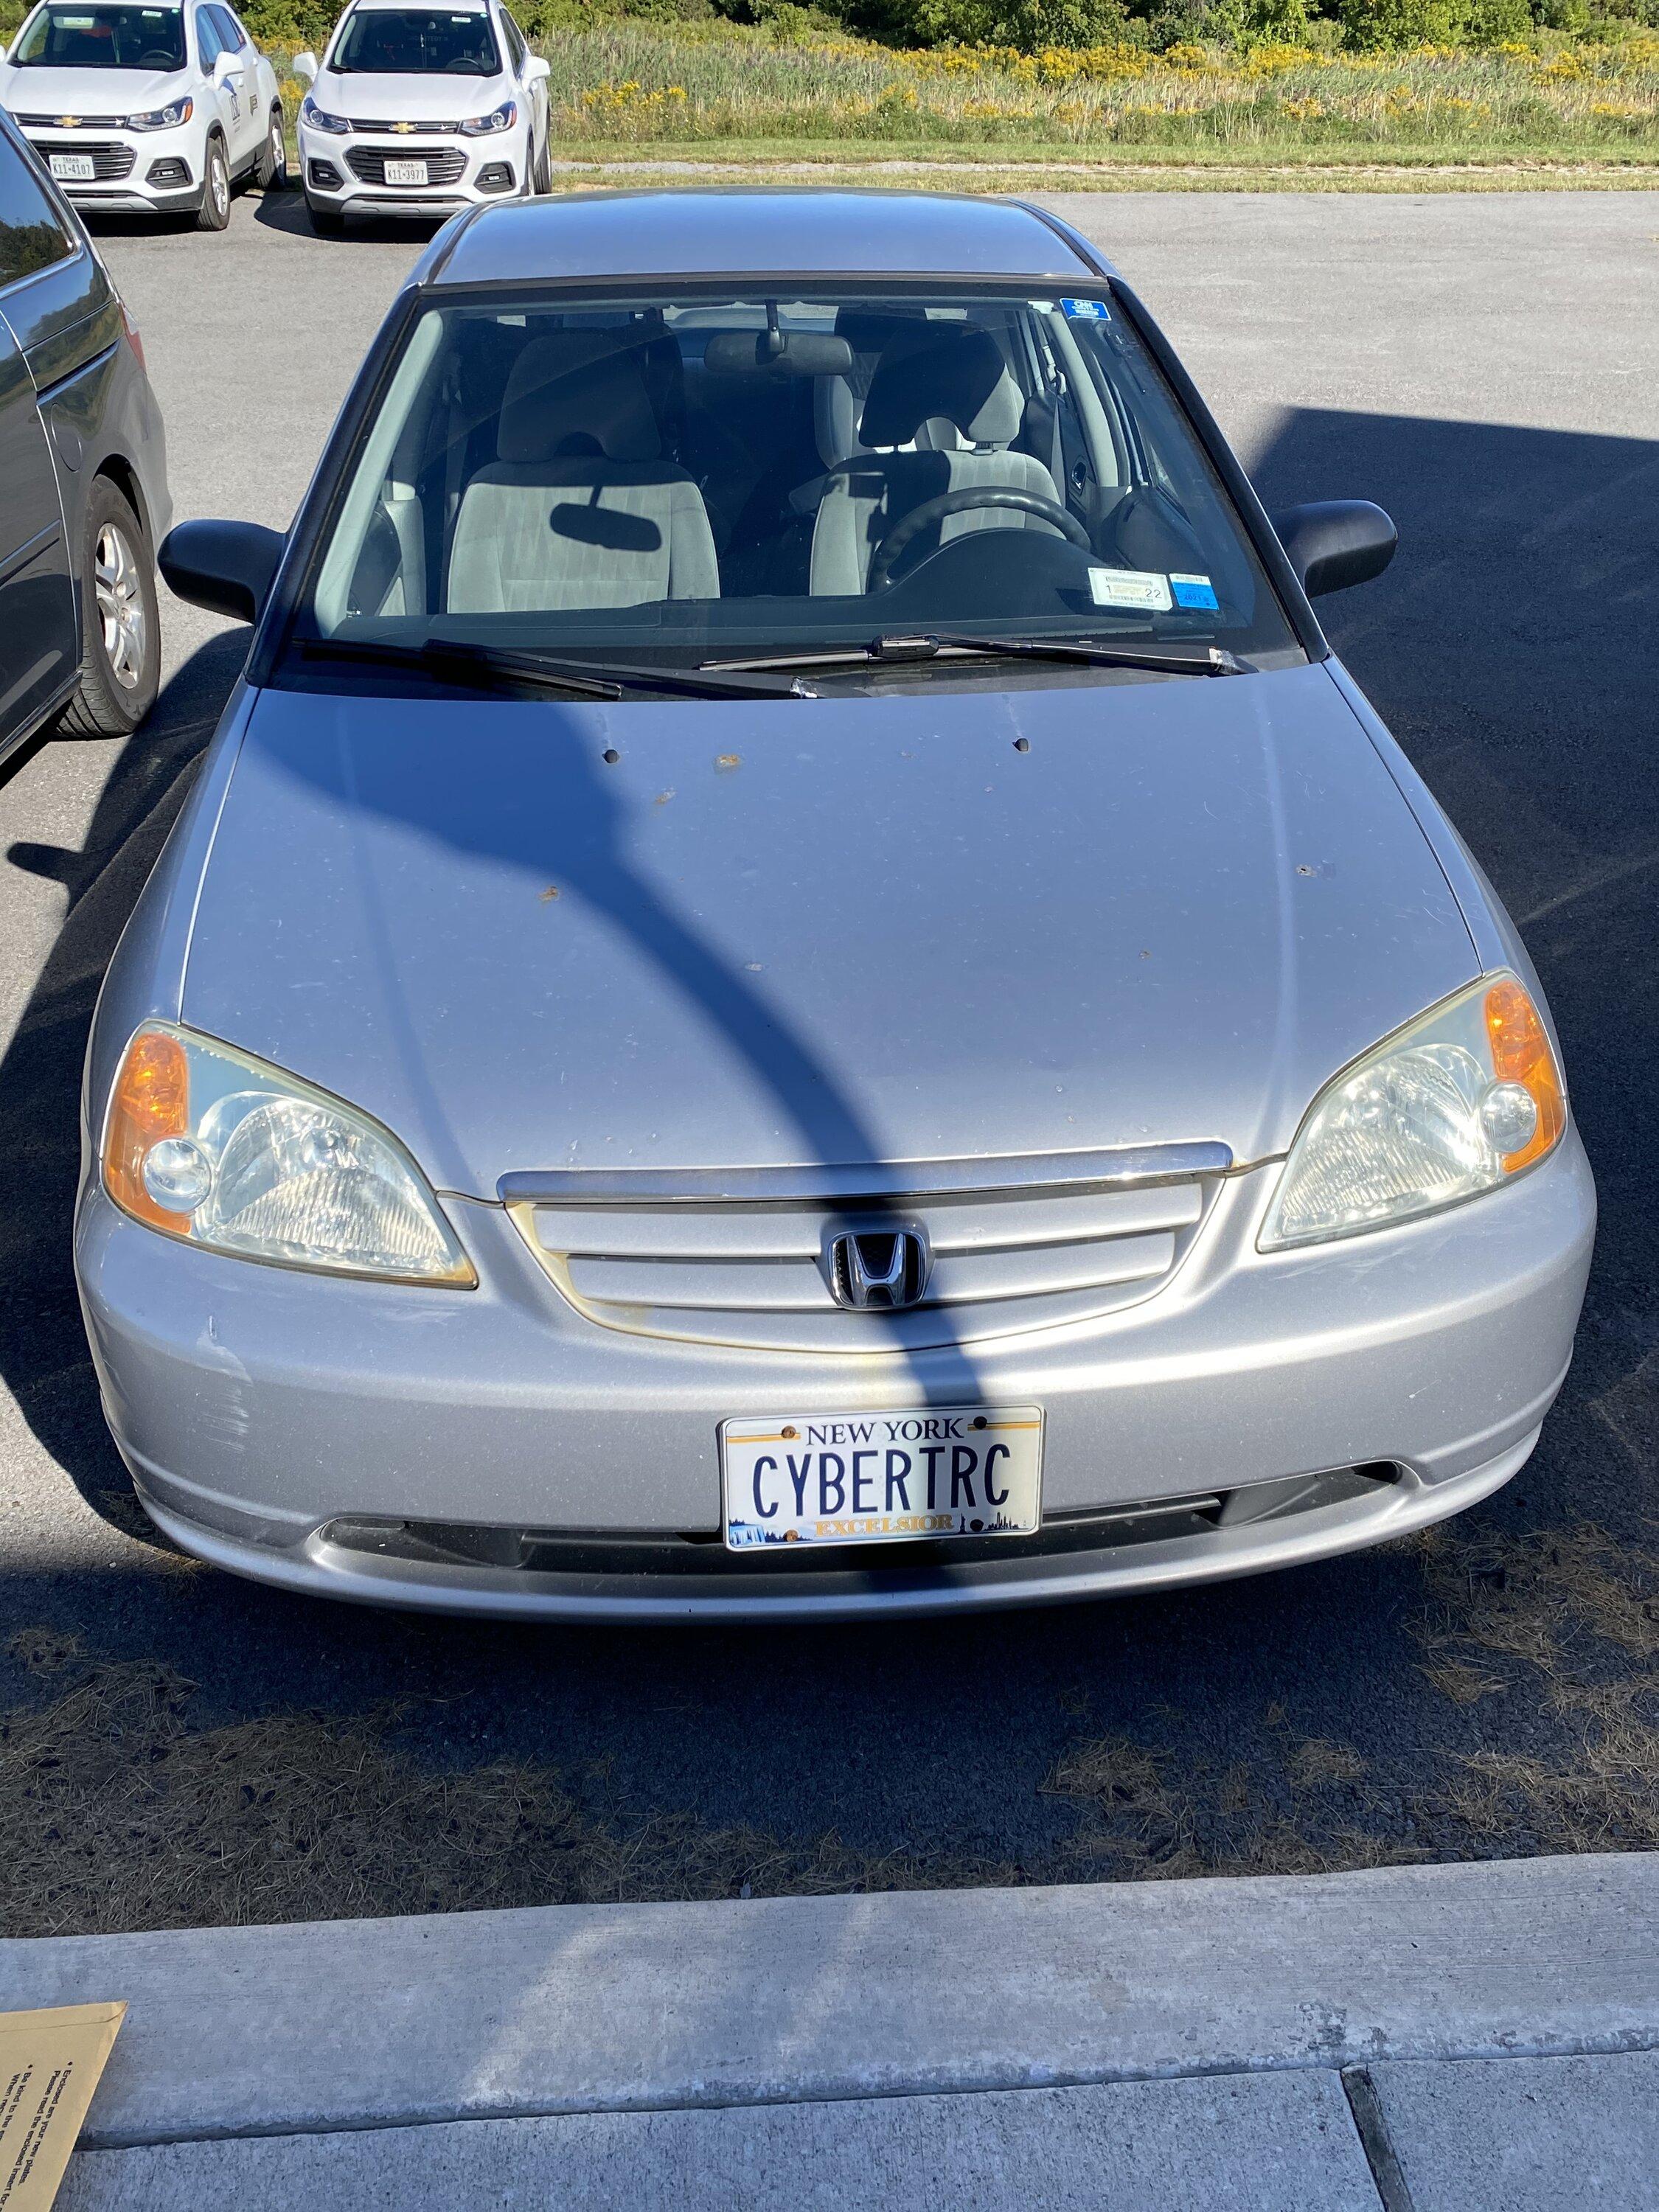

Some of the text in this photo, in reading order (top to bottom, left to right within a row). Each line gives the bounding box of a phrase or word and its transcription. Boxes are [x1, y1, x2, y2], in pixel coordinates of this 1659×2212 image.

[1145, 588, 1162, 599] 22
[806, 1417, 965, 1446] NEW YORK
[753, 1443, 1011, 1518] CYBERTRC
[814, 1514, 954, 1537] EXCELSIOR
[4, 2073, 21, 2096] When
[21, 2072, 32, 2083] Be
[45, 2070, 60, 2095] Please
[13, 2085, 26, 2102] kind
[52, 2070, 72, 2104] Enclosed
[9, 2105, 17, 2113] to
[37, 2097, 48, 2114] read
[46, 2107, 55, 2118] are
[2, 2115, 13, 2128] the
[31, 2115, 41, 2129] the
[38, 2121, 49, 2139] your
[15, 2130, 34, 2166] enclosed
[30, 2141, 41, 2157] new
